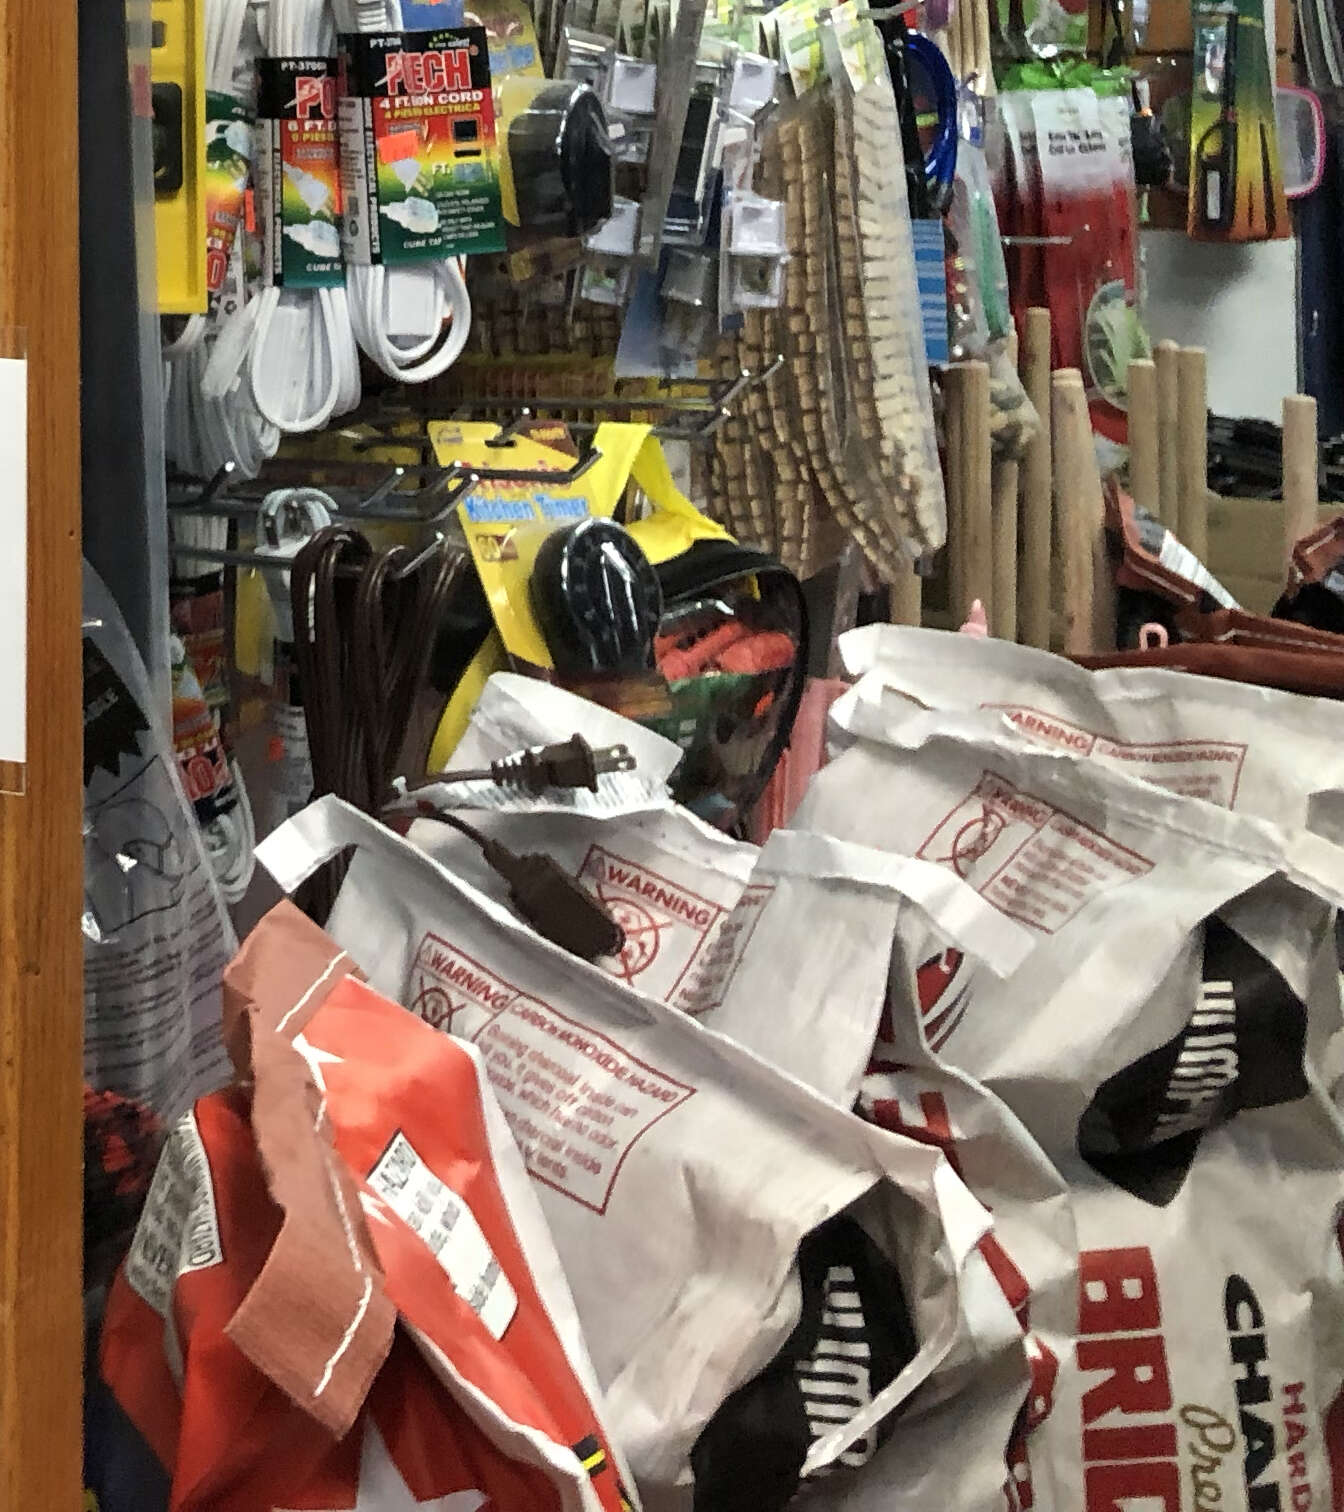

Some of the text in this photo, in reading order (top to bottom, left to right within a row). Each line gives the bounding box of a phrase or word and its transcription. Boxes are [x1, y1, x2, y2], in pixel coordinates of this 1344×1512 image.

[433, 91, 484, 106] CORD
[464, 493, 591, 523] Kitchen Timer
[606, 863, 713, 926] WARNING
[430, 951, 507, 1012] WARNING
